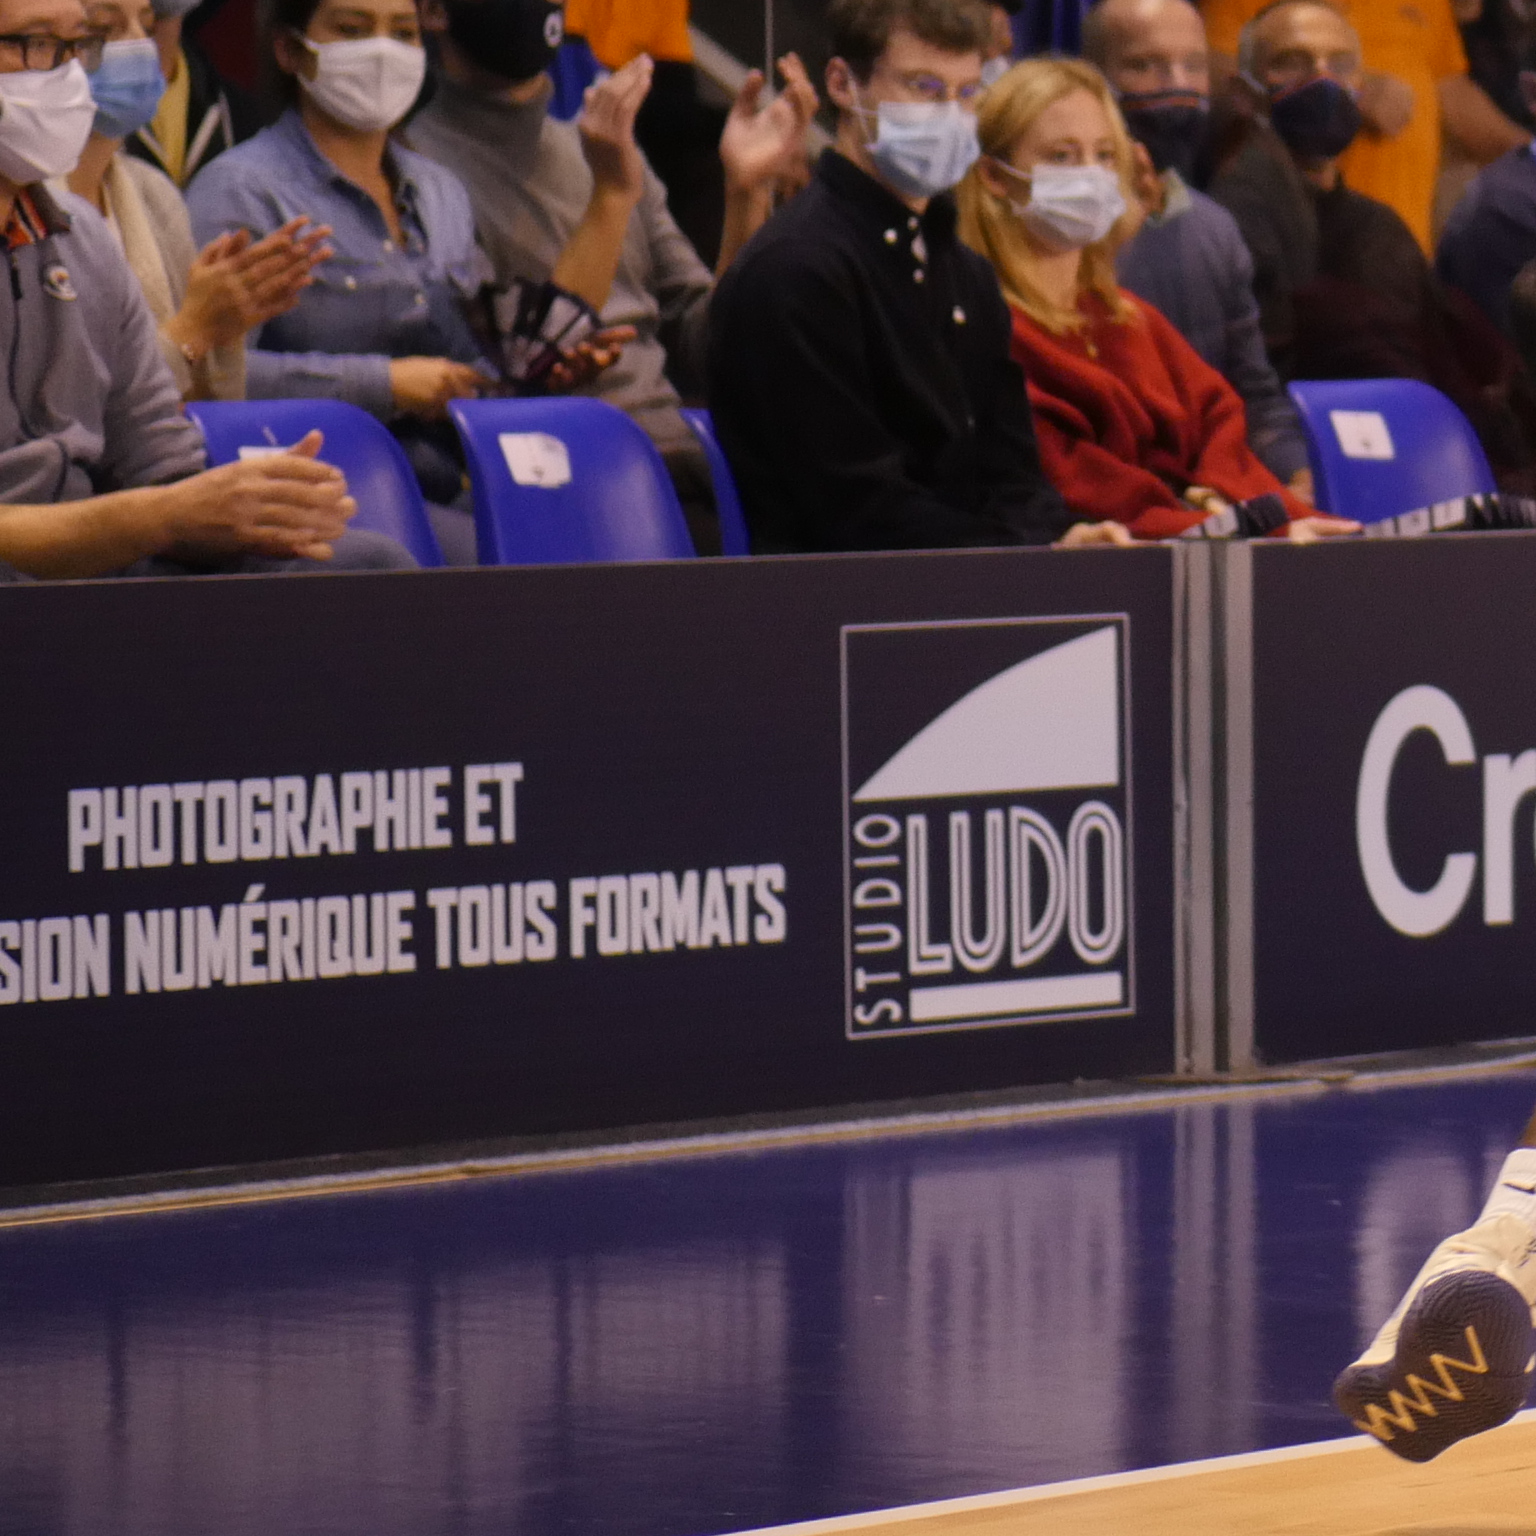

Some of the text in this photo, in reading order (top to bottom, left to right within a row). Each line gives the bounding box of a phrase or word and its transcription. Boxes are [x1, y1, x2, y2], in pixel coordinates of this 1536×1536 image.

[68, 763, 523, 872] PHOTOGRAPHIE ET
[906, 800, 1124, 976] LUDO
[124, 883, 416, 995] NUMÉRIQUE
[427, 880, 557, 970] TOUS
[569, 864, 786, 958] FORMATS
[853, 814, 902, 1024] STUDIO
